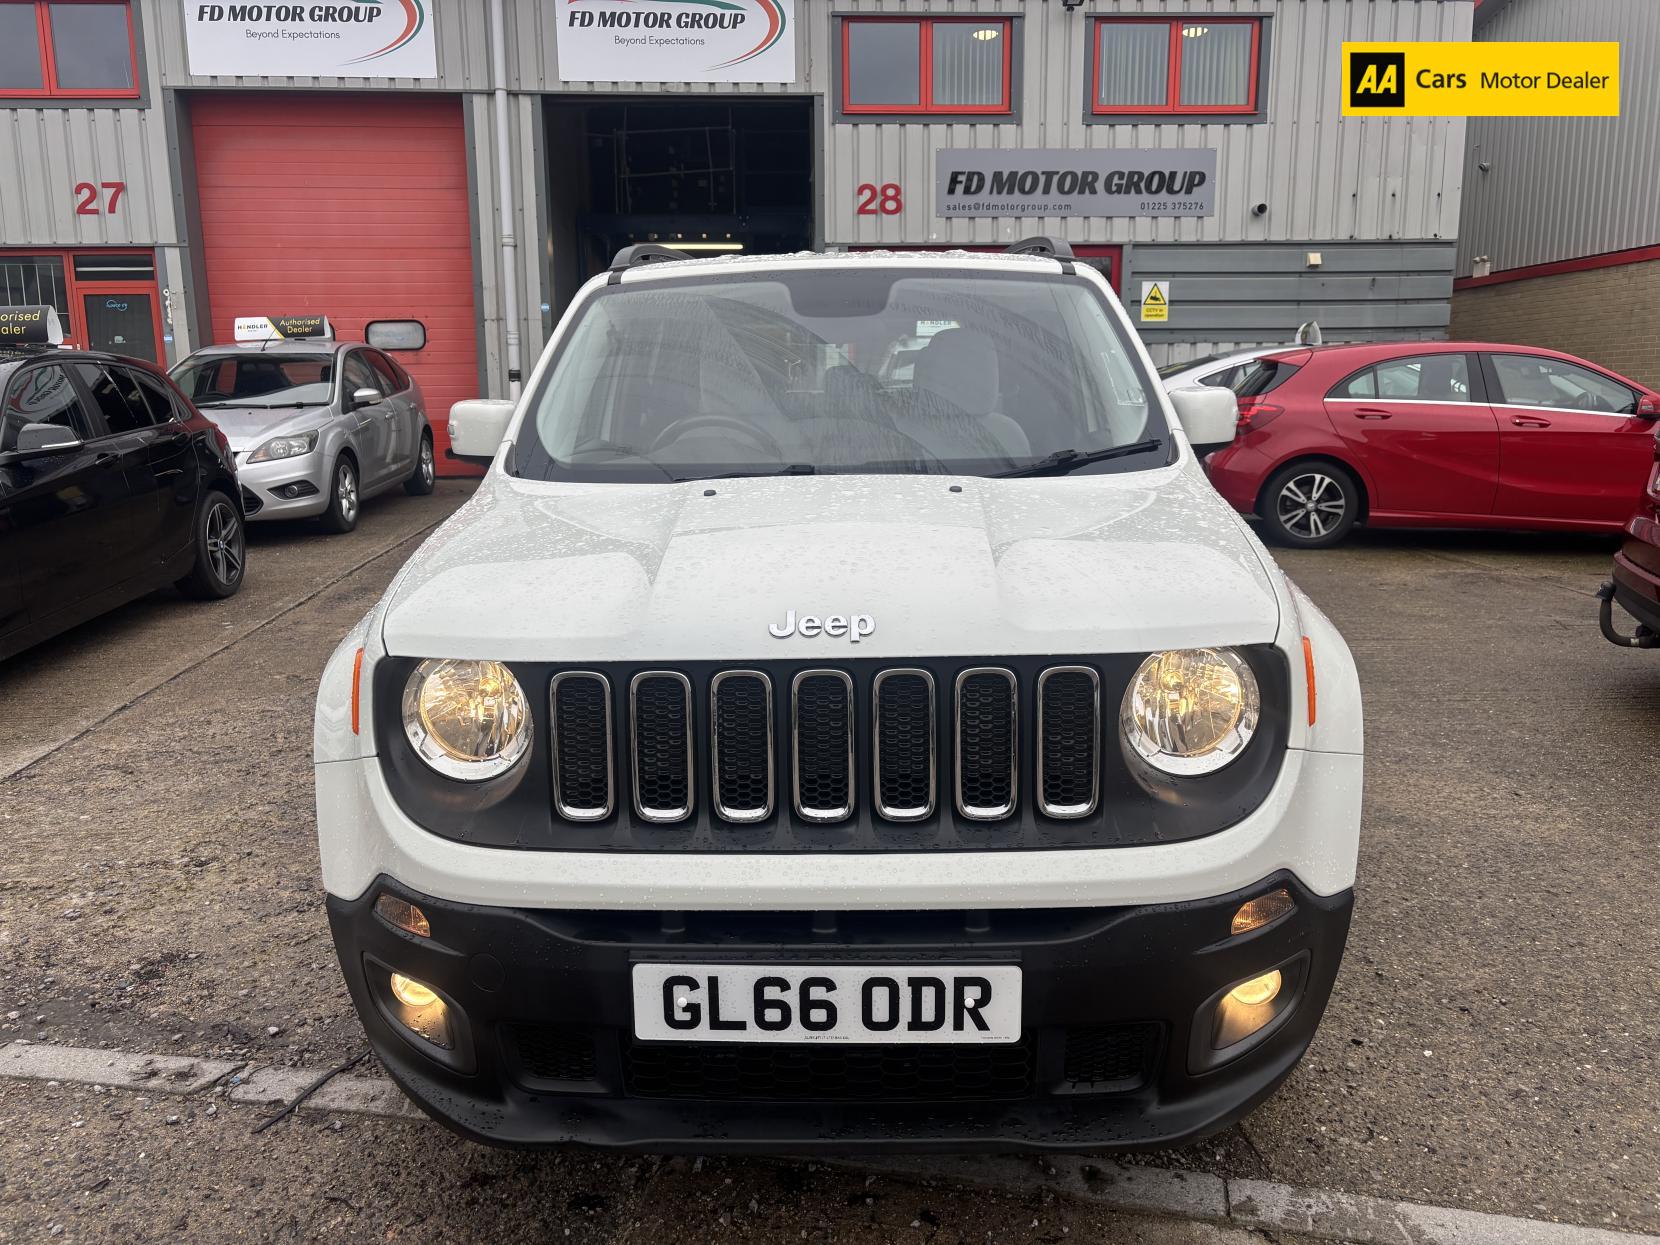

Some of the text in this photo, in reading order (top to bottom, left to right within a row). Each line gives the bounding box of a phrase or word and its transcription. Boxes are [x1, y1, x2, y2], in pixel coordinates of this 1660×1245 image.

[197, 5, 382, 23] FD MOTOR GROUP
[568, 10, 746, 30] FD MOTOR GROUP
[245, 29, 341, 40] Beyond Expectations
[614, 35, 705, 47] Beyond Expectations
[947, 170, 1207, 196] FD MOTOR GROUP
[74, 182, 125, 215] 27
[857, 183, 903, 215] 28
[946, 202, 1072, 213] sales@fdmotorgroup.com
[1140, 201, 1205, 211] 01225 375276
[279, 318, 321, 327] Authorised
[287, 325, 313, 334] Dealer
[768, 609, 876, 644] Jeep
[662, 975, 992, 1032] GL66 ODR
